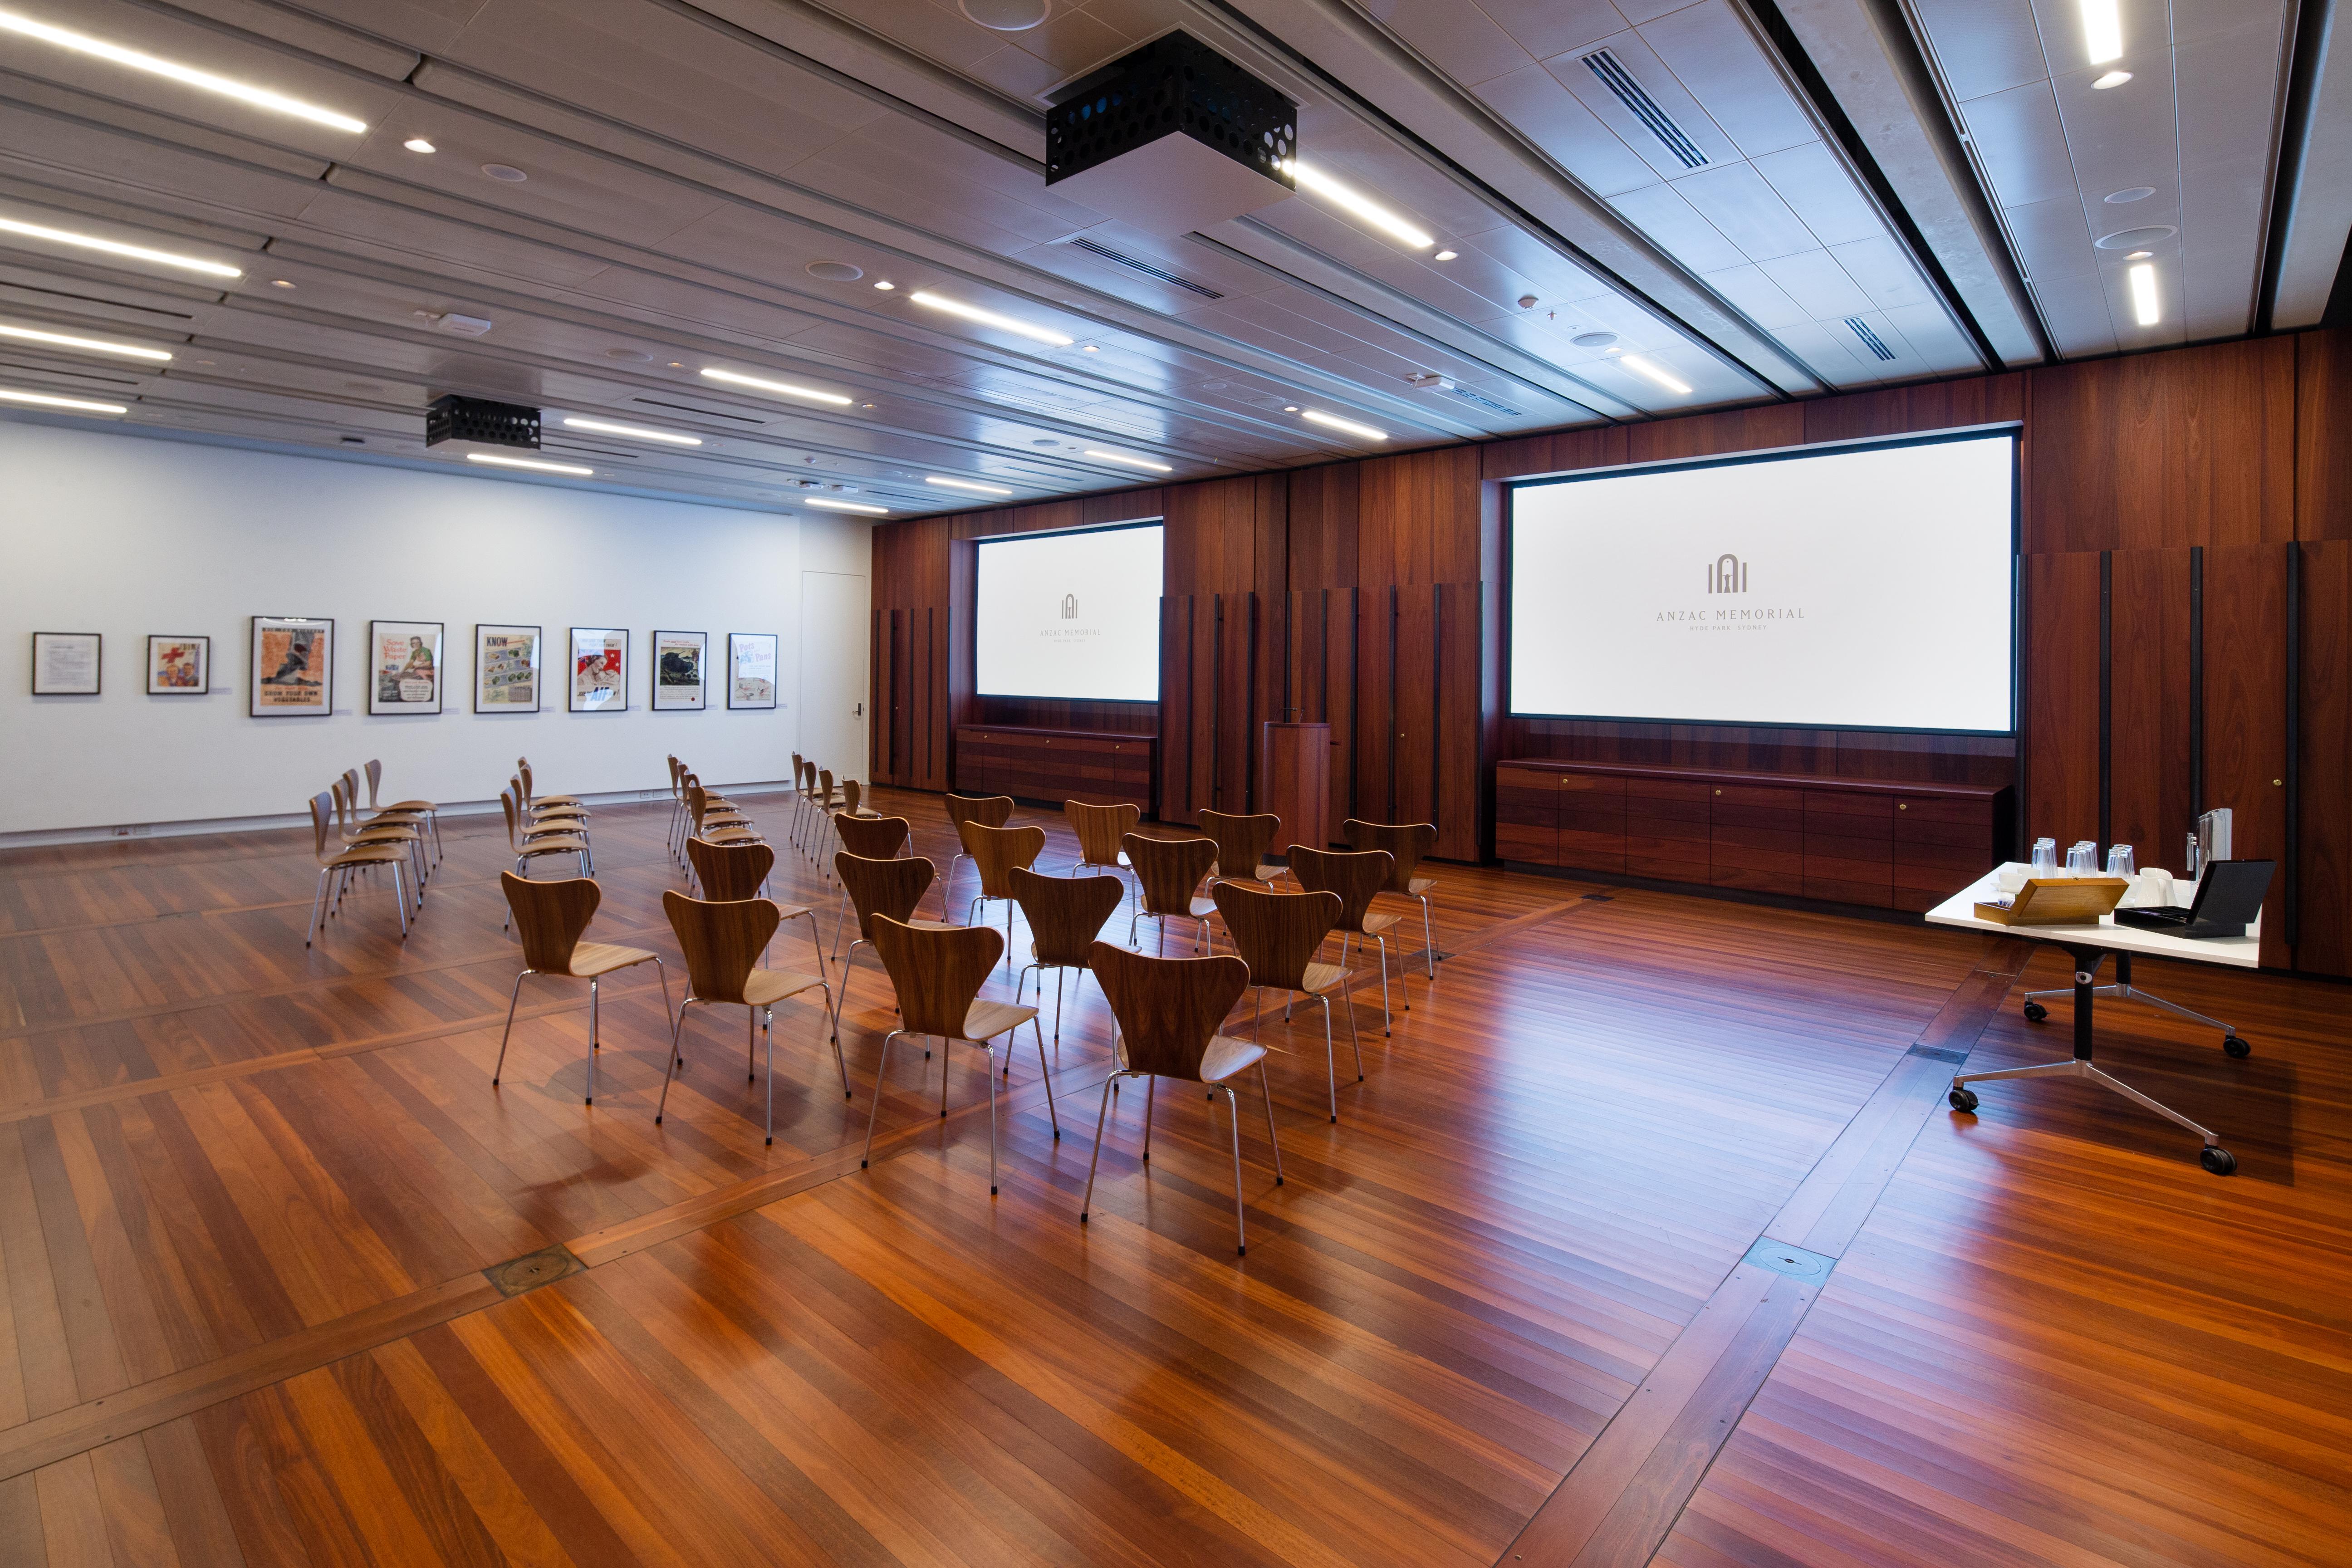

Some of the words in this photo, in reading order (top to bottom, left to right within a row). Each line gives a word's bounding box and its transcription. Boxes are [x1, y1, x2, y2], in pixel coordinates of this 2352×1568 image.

[1656, 610, 1706, 621] ANZAC
[1716, 608, 1805, 620] MEMORIAL
[487, 637, 508, 647] KNOW
[739, 642, 755, 652] Pots
[384, 652, 407, 661] Paper
[755, 653, 771, 662] Pans
[591, 686, 610, 701] AIF
